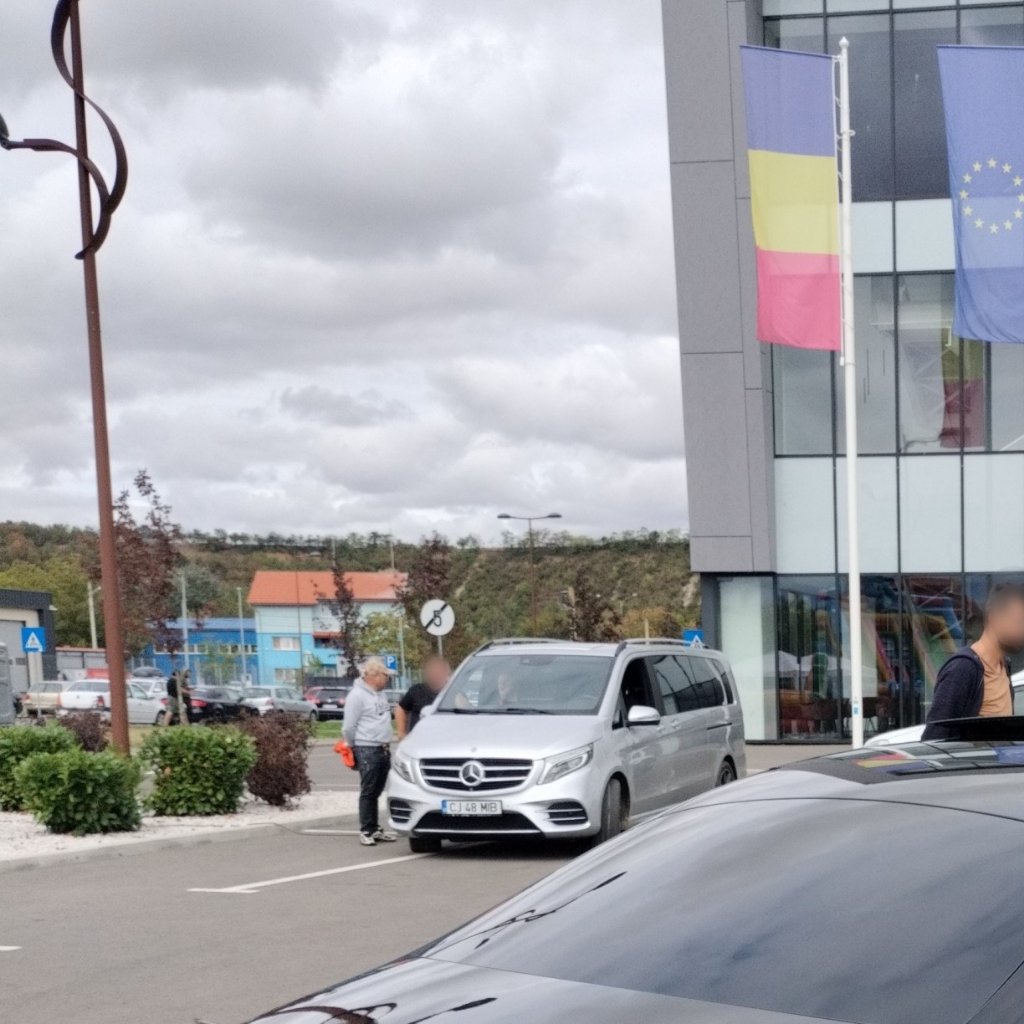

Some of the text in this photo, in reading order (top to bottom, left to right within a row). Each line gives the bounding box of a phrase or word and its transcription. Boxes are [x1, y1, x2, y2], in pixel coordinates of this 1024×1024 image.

[433, 610, 442, 627] 5
[449, 803, 497, 812] CJ 48 MIB
